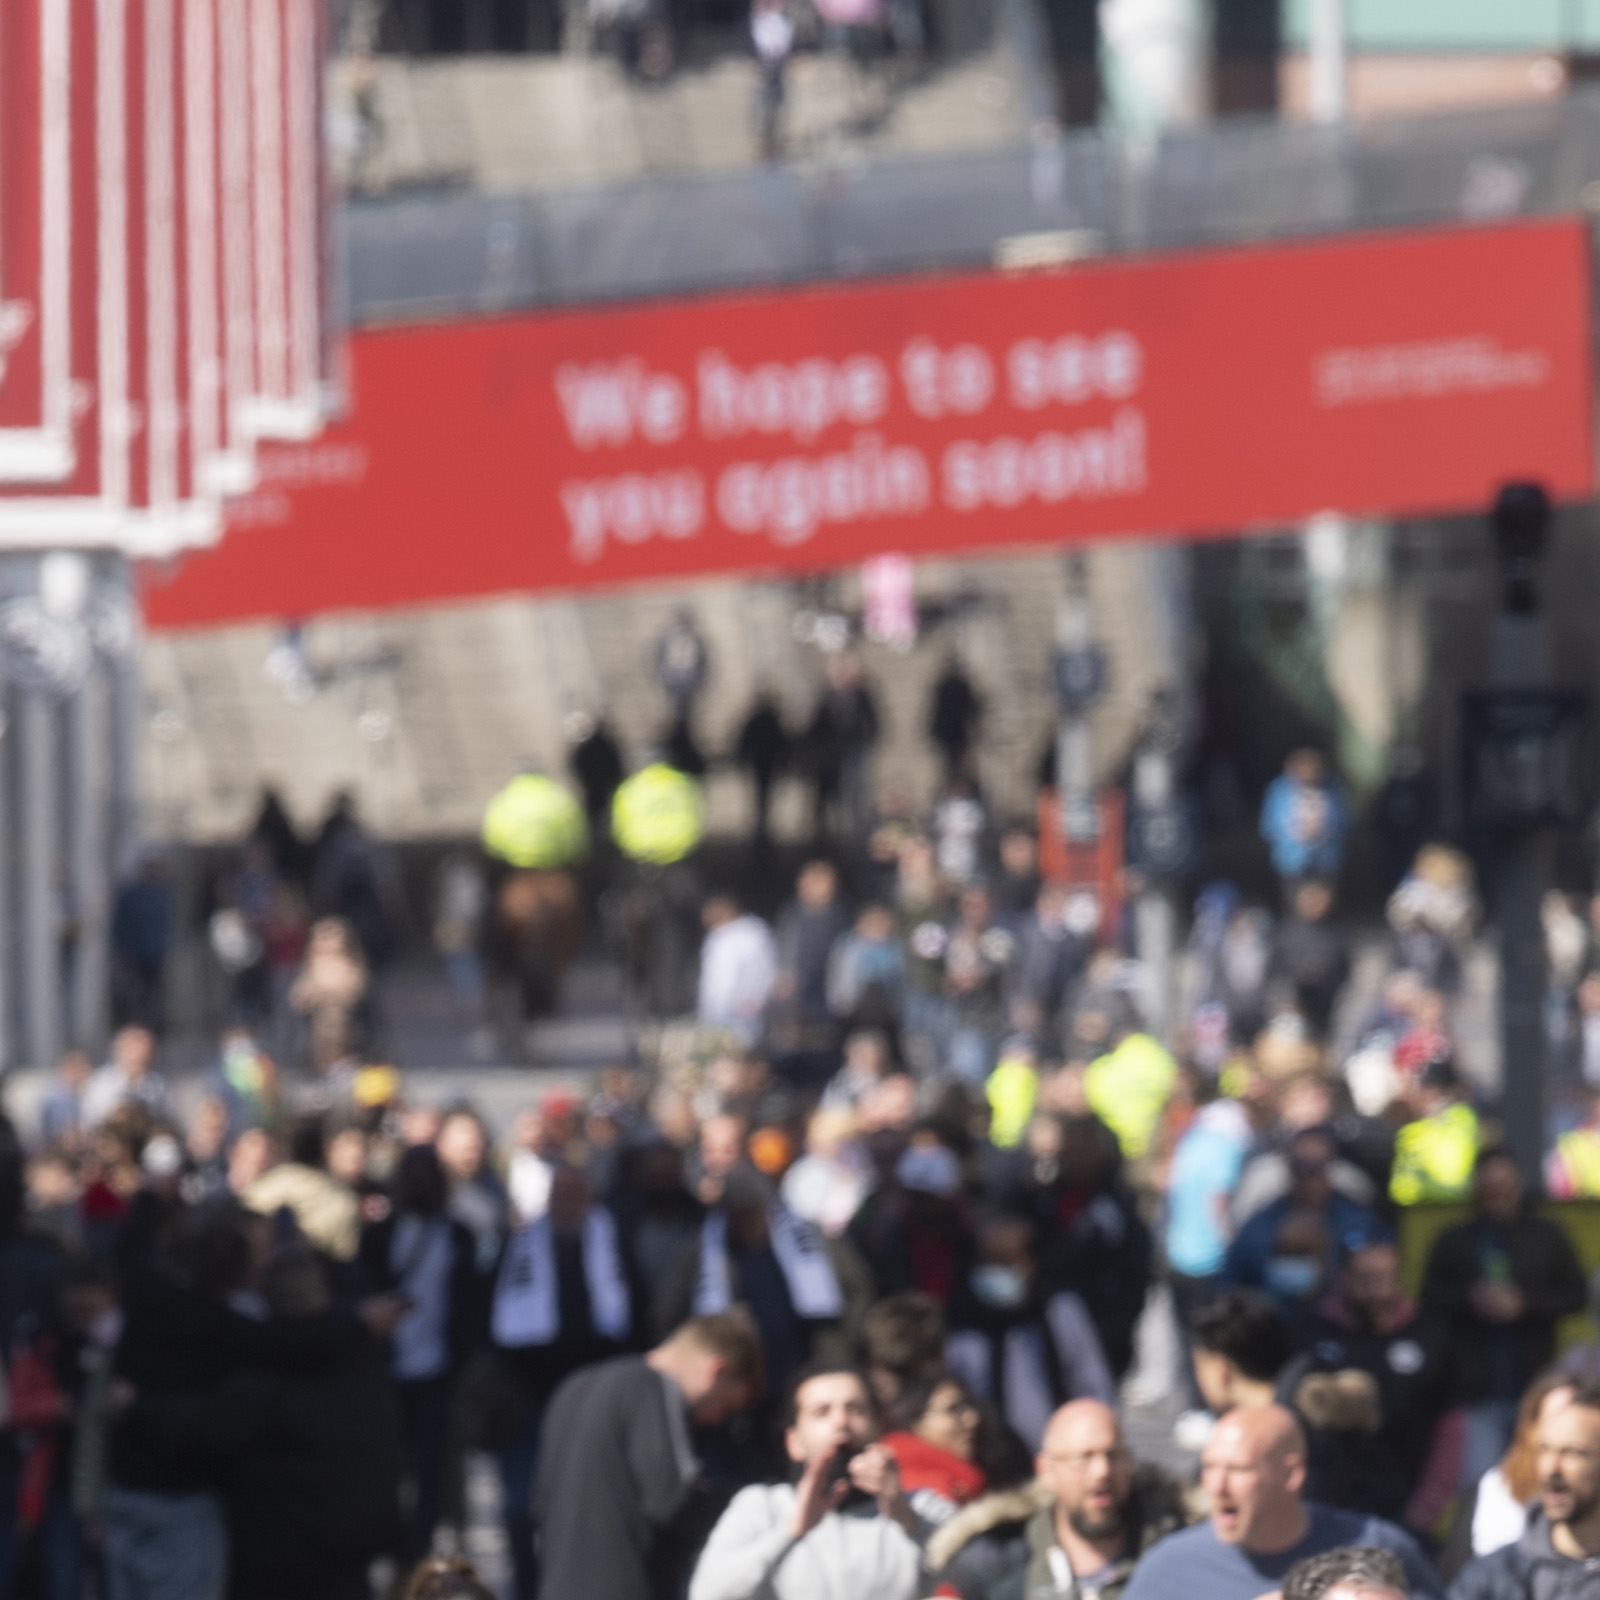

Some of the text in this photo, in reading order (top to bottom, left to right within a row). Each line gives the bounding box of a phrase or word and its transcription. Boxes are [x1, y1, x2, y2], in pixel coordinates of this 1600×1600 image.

[557, 332, 1142, 450] We hope to see
[560, 407, 1147, 563] you again soon!
